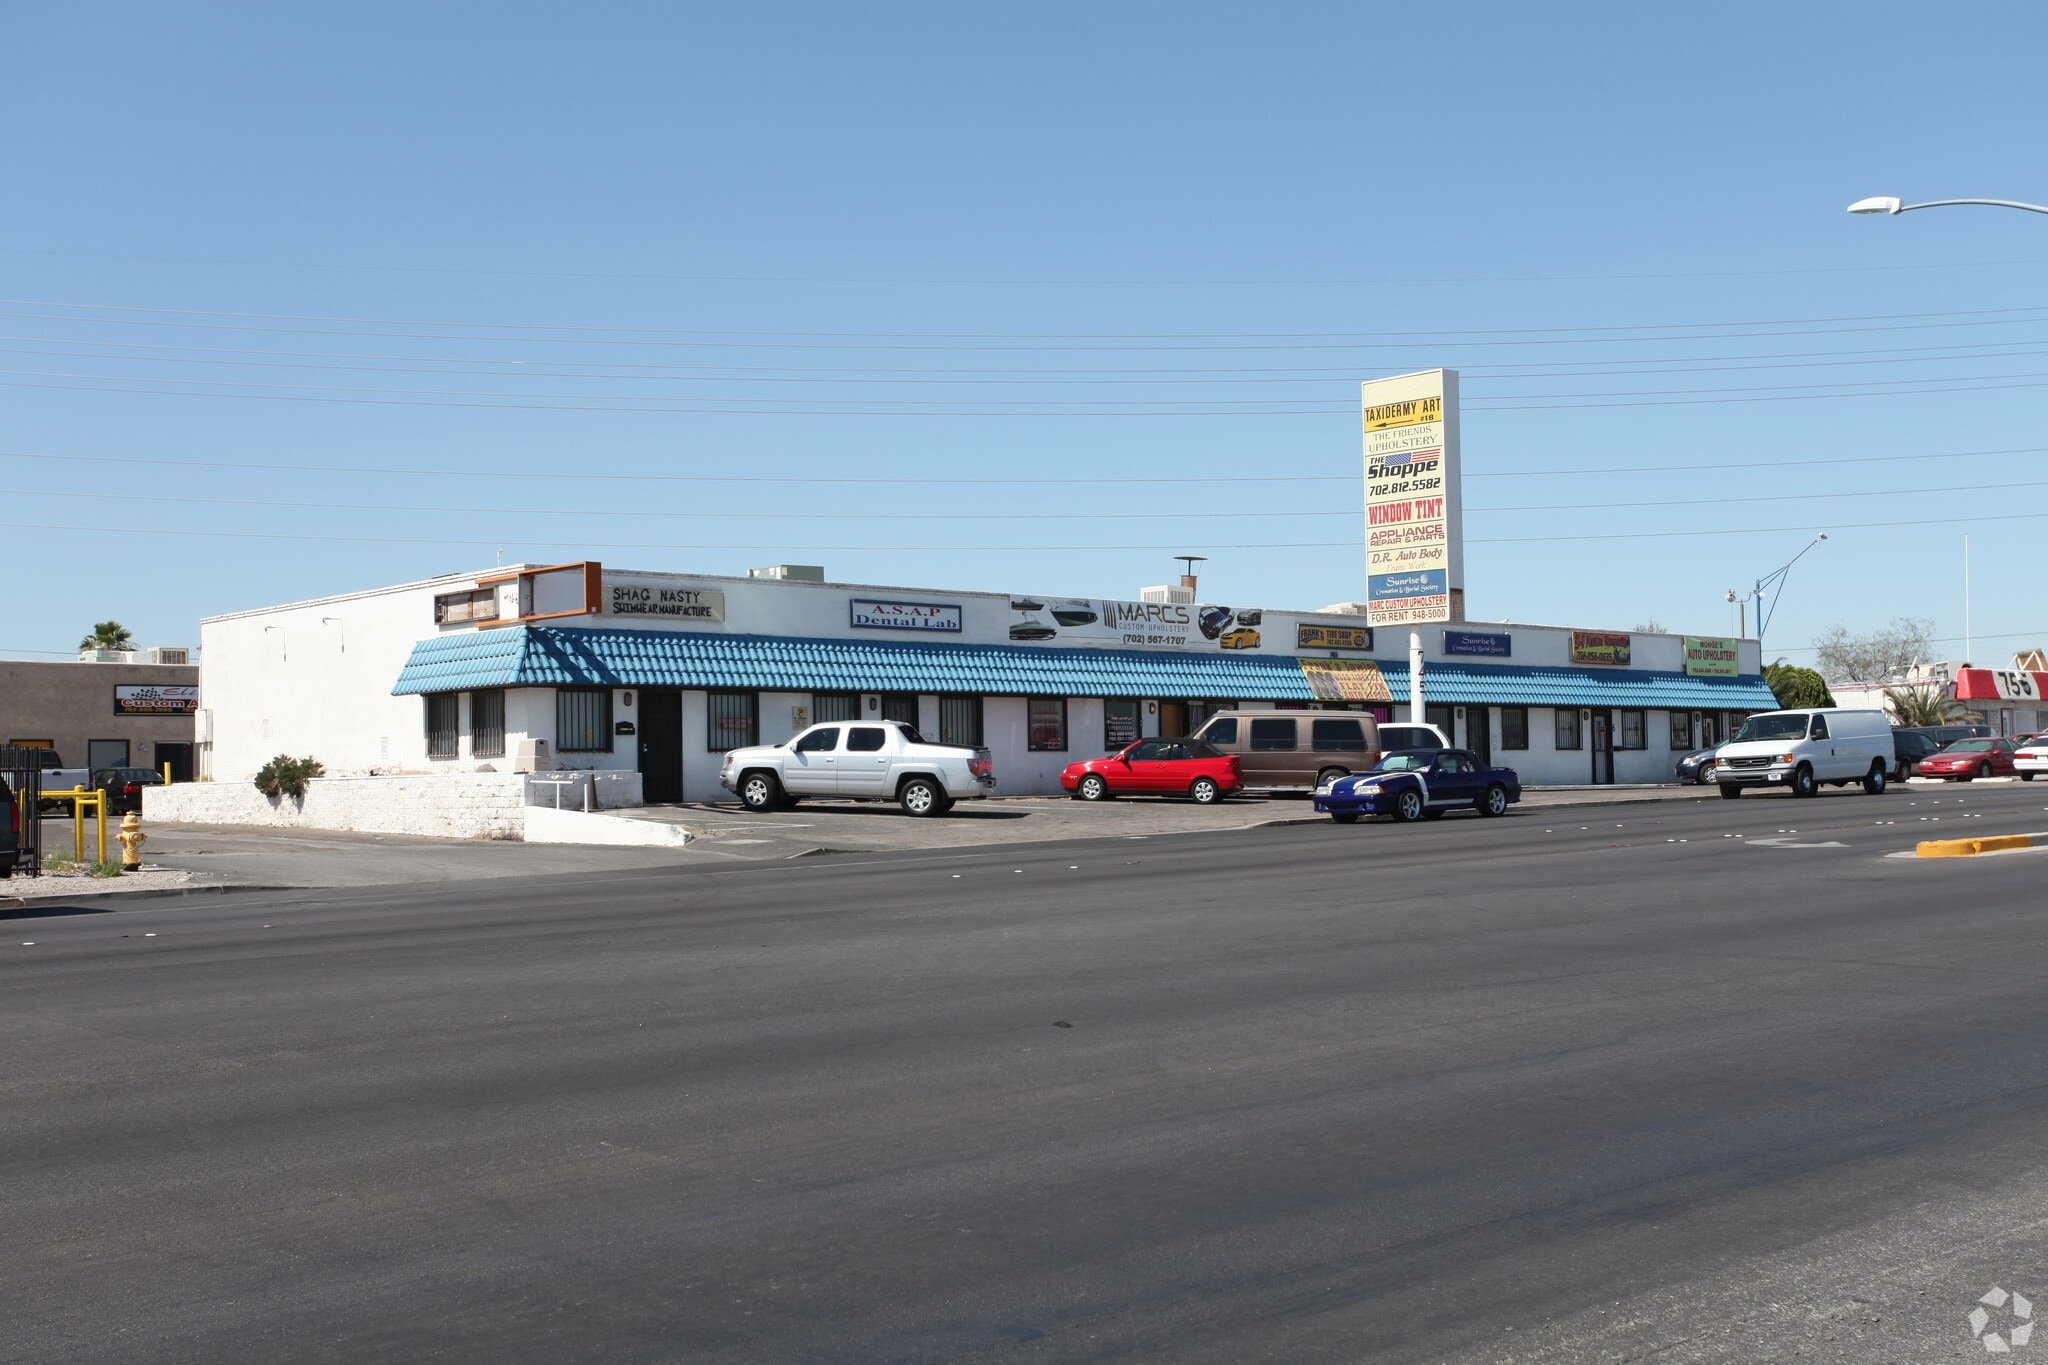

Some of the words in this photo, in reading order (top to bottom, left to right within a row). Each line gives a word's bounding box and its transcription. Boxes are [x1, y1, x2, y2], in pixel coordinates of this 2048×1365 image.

[1365, 402, 1416, 422] TAXIDERMY
[1422, 398, 1440, 413] ART
[1374, 432, 1391, 441] THE
[1393, 425, 1431, 438] FRIENDS
[1369, 434, 1438, 453] UPHOLSTERY
[1370, 456, 1385, 464] THE
[1368, 460, 1438, 479] Shoppe
[1369, 477, 1440, 497] 702.812.5582
[1369, 501, 1412, 525] WINDOW
[1415, 498, 1443, 519] TINT
[1370, 524, 1443, 540] APPLIANCE
[1370, 537, 1402, 547] REPAIR
[1413, 532, 1445, 542] PARTS
[1371, 552, 1392, 564] D.R.
[1395, 550, 1417, 561] Auto
[1418, 547, 1443, 559] Body
[1386, 576, 1419, 587] Sunrise
[613, 588, 651, 601] SHAG
[660, 590, 700, 604] NASTY
[1368, 602, 1384, 611] MARC
[1385, 599, 1409, 610] CUSTOM
[1409, 595, 1447, 608] UPHOLSTERY
[612, 601, 658, 614] SWIMWEAR
[659, 603, 712, 617] MANUFACTURE
[872, 605, 941, 617] A.S.A.P
[1117, 602, 1190, 624] MARCS
[1371, 613, 1387, 623] FOR
[1388, 611, 1409, 621] RENT
[1412, 608, 1446, 619] 948-5000
[856, 614, 917, 626] Dental
[923, 618, 957, 628] Lab
[1118, 622, 1145, 631] CUSTOM
[1149, 624, 1190, 633] UPHOLSTERY
[1122, 633, 1145, 645] (702)
[1461, 635, 1490, 645] Sunrise
[1687, 649, 1703, 660] AUTO
[1703, 650, 1737, 662] UPHOLSTERY
[121, 699, 185, 708] Custom
